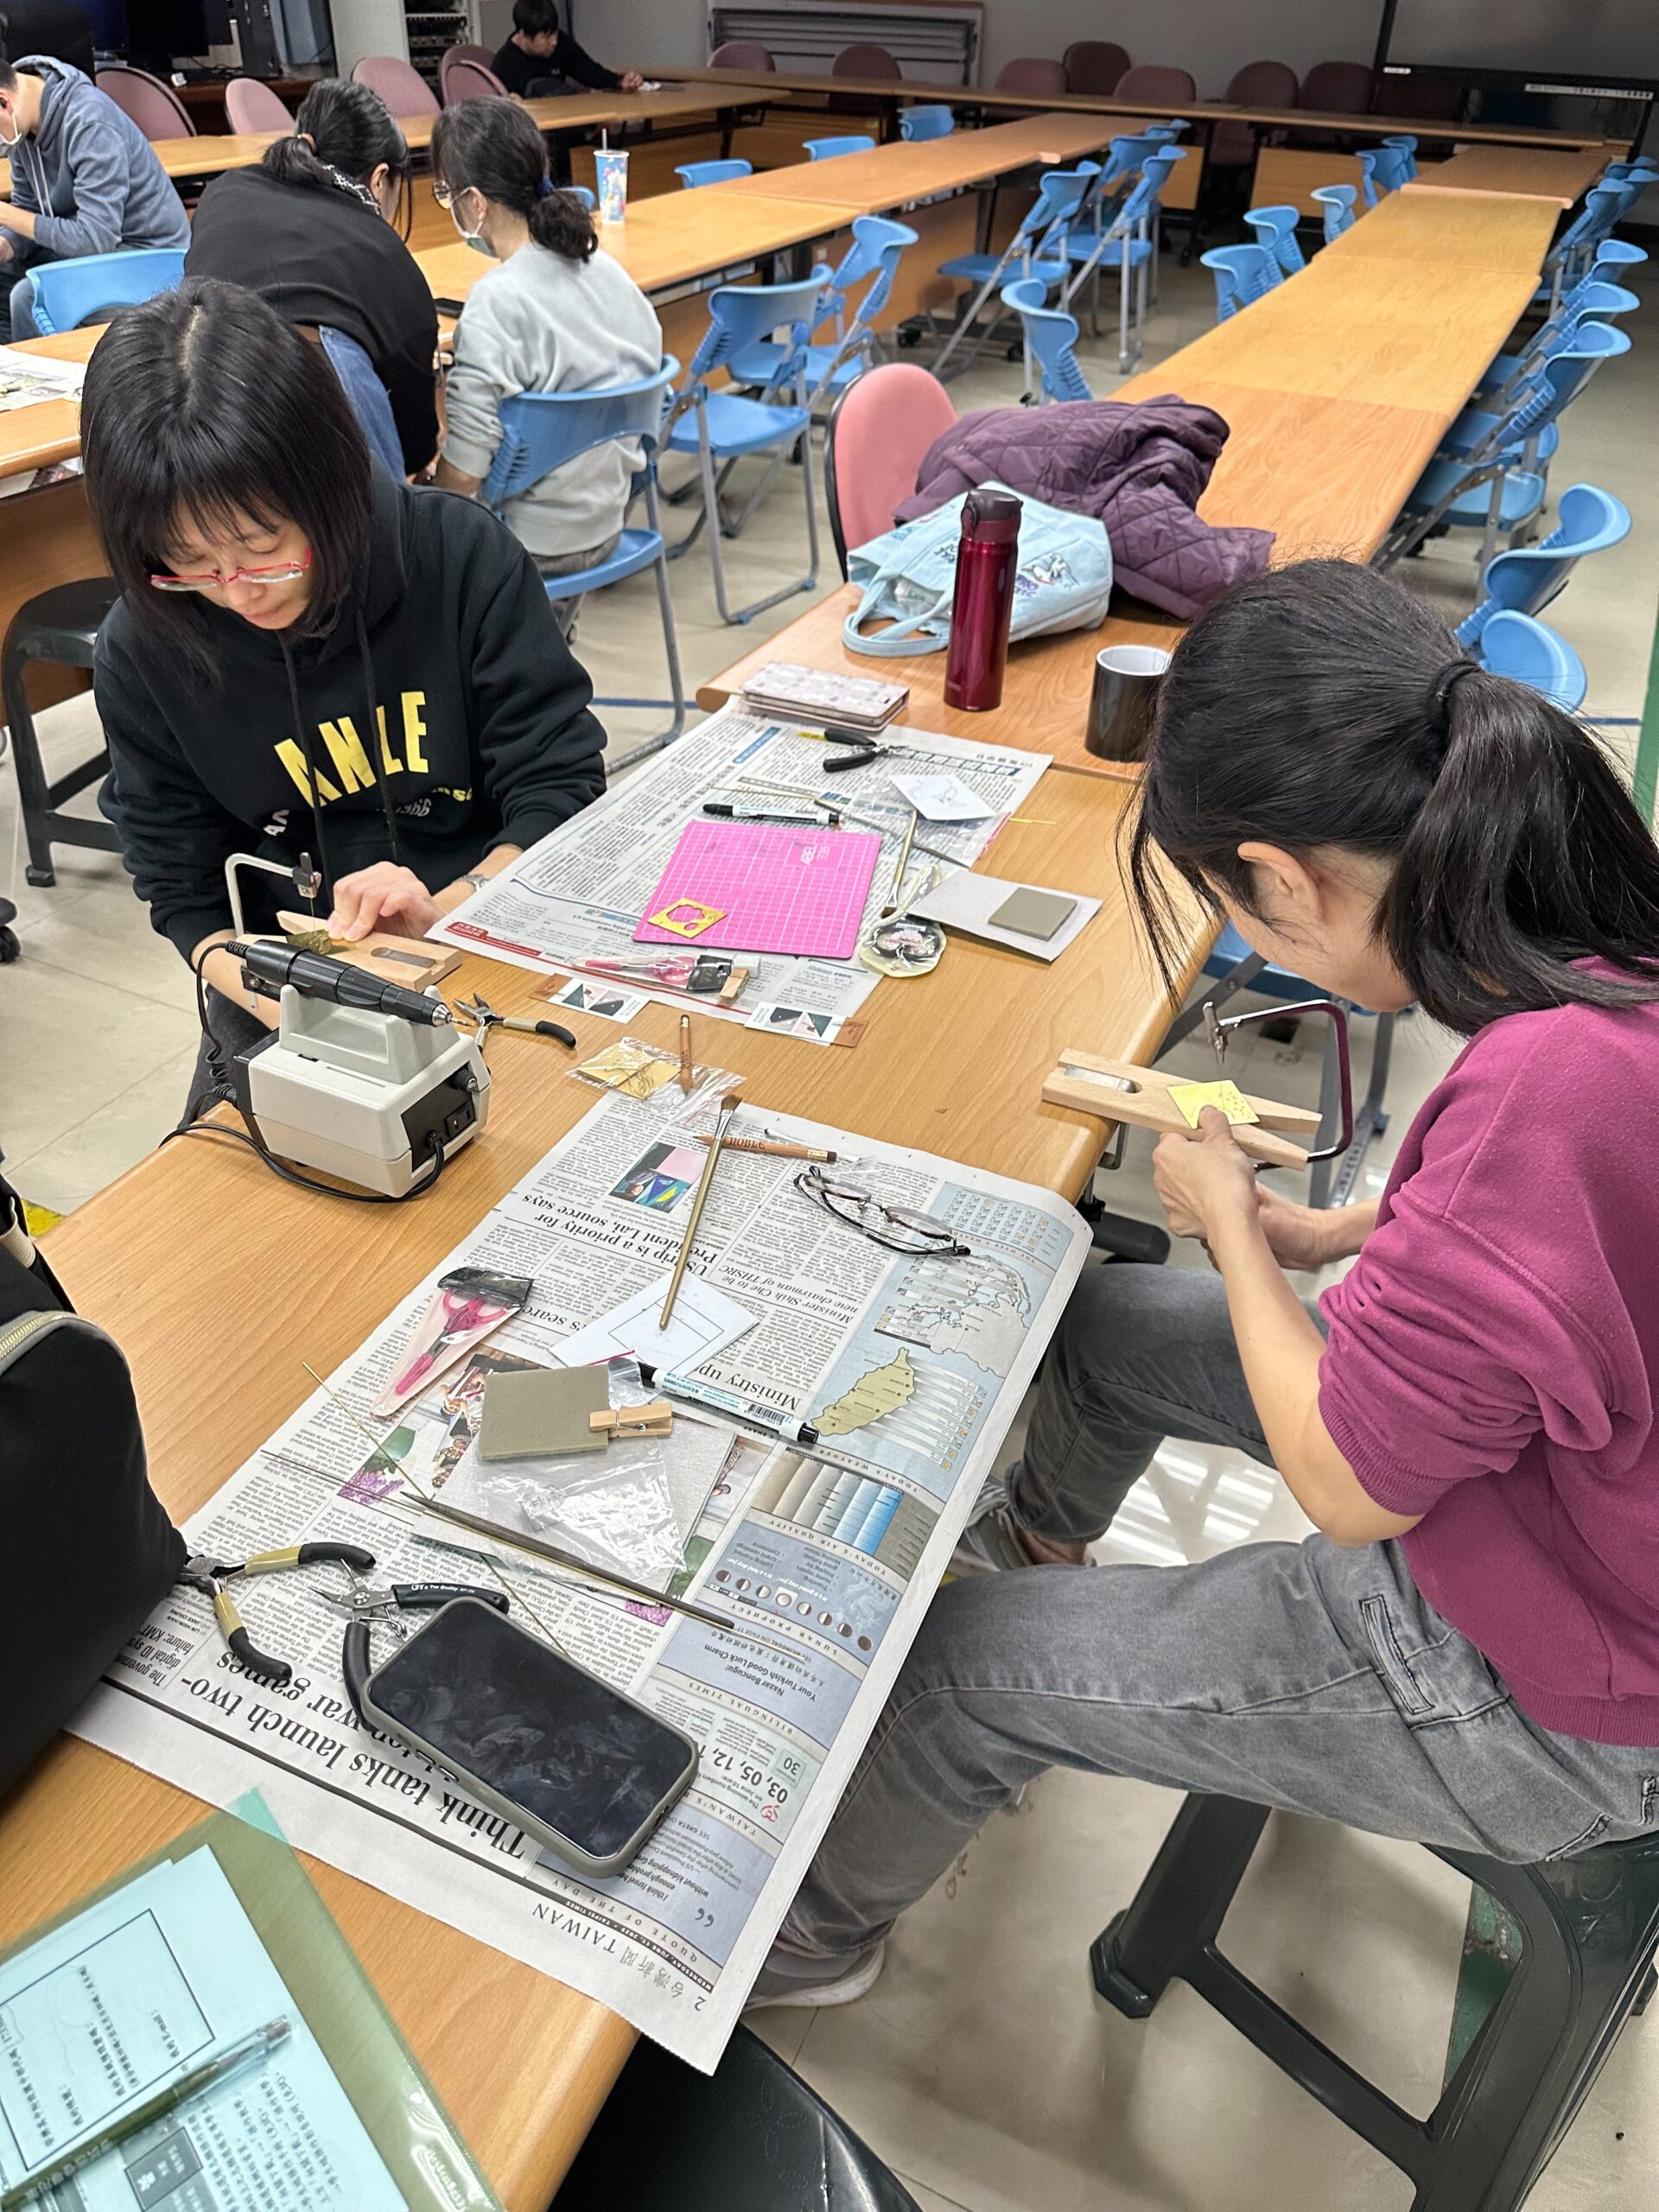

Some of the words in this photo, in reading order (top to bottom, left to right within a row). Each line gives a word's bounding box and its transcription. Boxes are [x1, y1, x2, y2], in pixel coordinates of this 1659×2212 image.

[519, 1192, 557, 1211] says
[531, 1212, 560, 1228] for
[554, 1205, 610, 1228] source
[557, 1218, 626, 1249] priority
[607, 1221, 642, 1239] Lai,
[620, 1240, 633, 1249] a
[632, 1244, 650, 1257] is
[639, 1231, 718, 1263] Preident
[682, 1260, 709, 1275] US
[716, 1263, 761, 1283] THSRC
[719, 1274, 735, 1285] be
[735, 1280, 748, 1288] to
[760, 1276, 776, 1287] of
[747, 1284, 772, 1297] Che
[772, 1292, 802, 1306] Shih
[775, 1281, 832, 1306] chairman
[800, 1300, 853, 1323] Minister
[833, 1300, 858, 1313] new
[722, 1371, 802, 1411] Ministry
[817, 1448, 869, 1470] WEATHER
[875, 1469, 918, 1491] TODAY'S
[767, 1518, 815, 1541] QUALITY
[818, 1538, 838, 1550] AIR
[842, 1548, 887, 1575] TODAY'S
[165, 1614, 192, 1629] HSIN-HAN
[168, 1608, 188, 1619] CHUNG
[187, 1616, 201, 1625] JAKE
[729, 1603, 791, 1630] PROPHECY
[139, 1623, 166, 1642] KMT
[138, 1643, 156, 1658] ID
[159, 1632, 194, 1656] failure:
[702, 1643, 729, 1659] Charm
[798, 1630, 837, 1655] LUNAR
[149, 1646, 183, 1671] digital
[728, 1653, 747, 1667] Luck
[746, 1661, 770, 1675] Good
[145, 1669, 168, 1686] The
[722, 1662, 763, 1685] Boncugu:
[767, 1670, 798, 1691] Turkish
[173, 1670, 245, 1717] two-
[687, 1681, 722, 1700] TIMES
[760, 1679, 785, 1696] Nazar
[797, 1685, 817, 1702] Your
[304, 1691, 368, 1732] war
[728, 1698, 793, 1734] BILINGUAL
[238, 1702, 349, 1770] launch
[707, 1746, 737, 1771] 12,
[781, 1755, 801, 1776] 30
[343, 1750, 433, 1810] tanks
[700, 1772, 728, 1789] numbers
[734, 1759, 765, 1787] 05,
[725, 1783, 749, 1802] winning
[731, 1779, 741, 1789] 10
[739, 1784, 755, 1796] June
[760, 1775, 790, 1804] 03,
[747, 1797, 760, 1808] The
[428, 1790, 534, 1860] Think
[695, 1796, 756, 1835] TAIWAN'S
[677, 1819, 698, 1834] GRETA
[658, 1847, 687, 1866] President
[683, 1861, 695, 1871] US
[625, 1859, 652, 1879] proble
[646, 1857, 685, 1884] kidnapping
[550, 1876, 581, 1896] DAY
[626, 1875, 648, 1891] Israel
[648, 1870, 677, 1891] enough
[683, 1877, 710, 1898] without
[644, 1884, 665, 1900] think
[564, 1898, 588, 1914] TIMES
[588, 1894, 616, 1913] THE
[586, 1909, 611, 1926] TAIPEI
[624, 1912, 643, 1927] OF
[531, 1900, 620, 1955] TAIWAN
[618, 1925, 639, 1941] 2025
[649, 1926, 698, 1963] QUOTE
[651, 1942, 670, 1960] JUNE
[618, 1944, 686, 2001] 台灣新聞
[668, 1955, 713, 1991] WEDNESDAY,
[691, 1994, 707, 2012] 2
